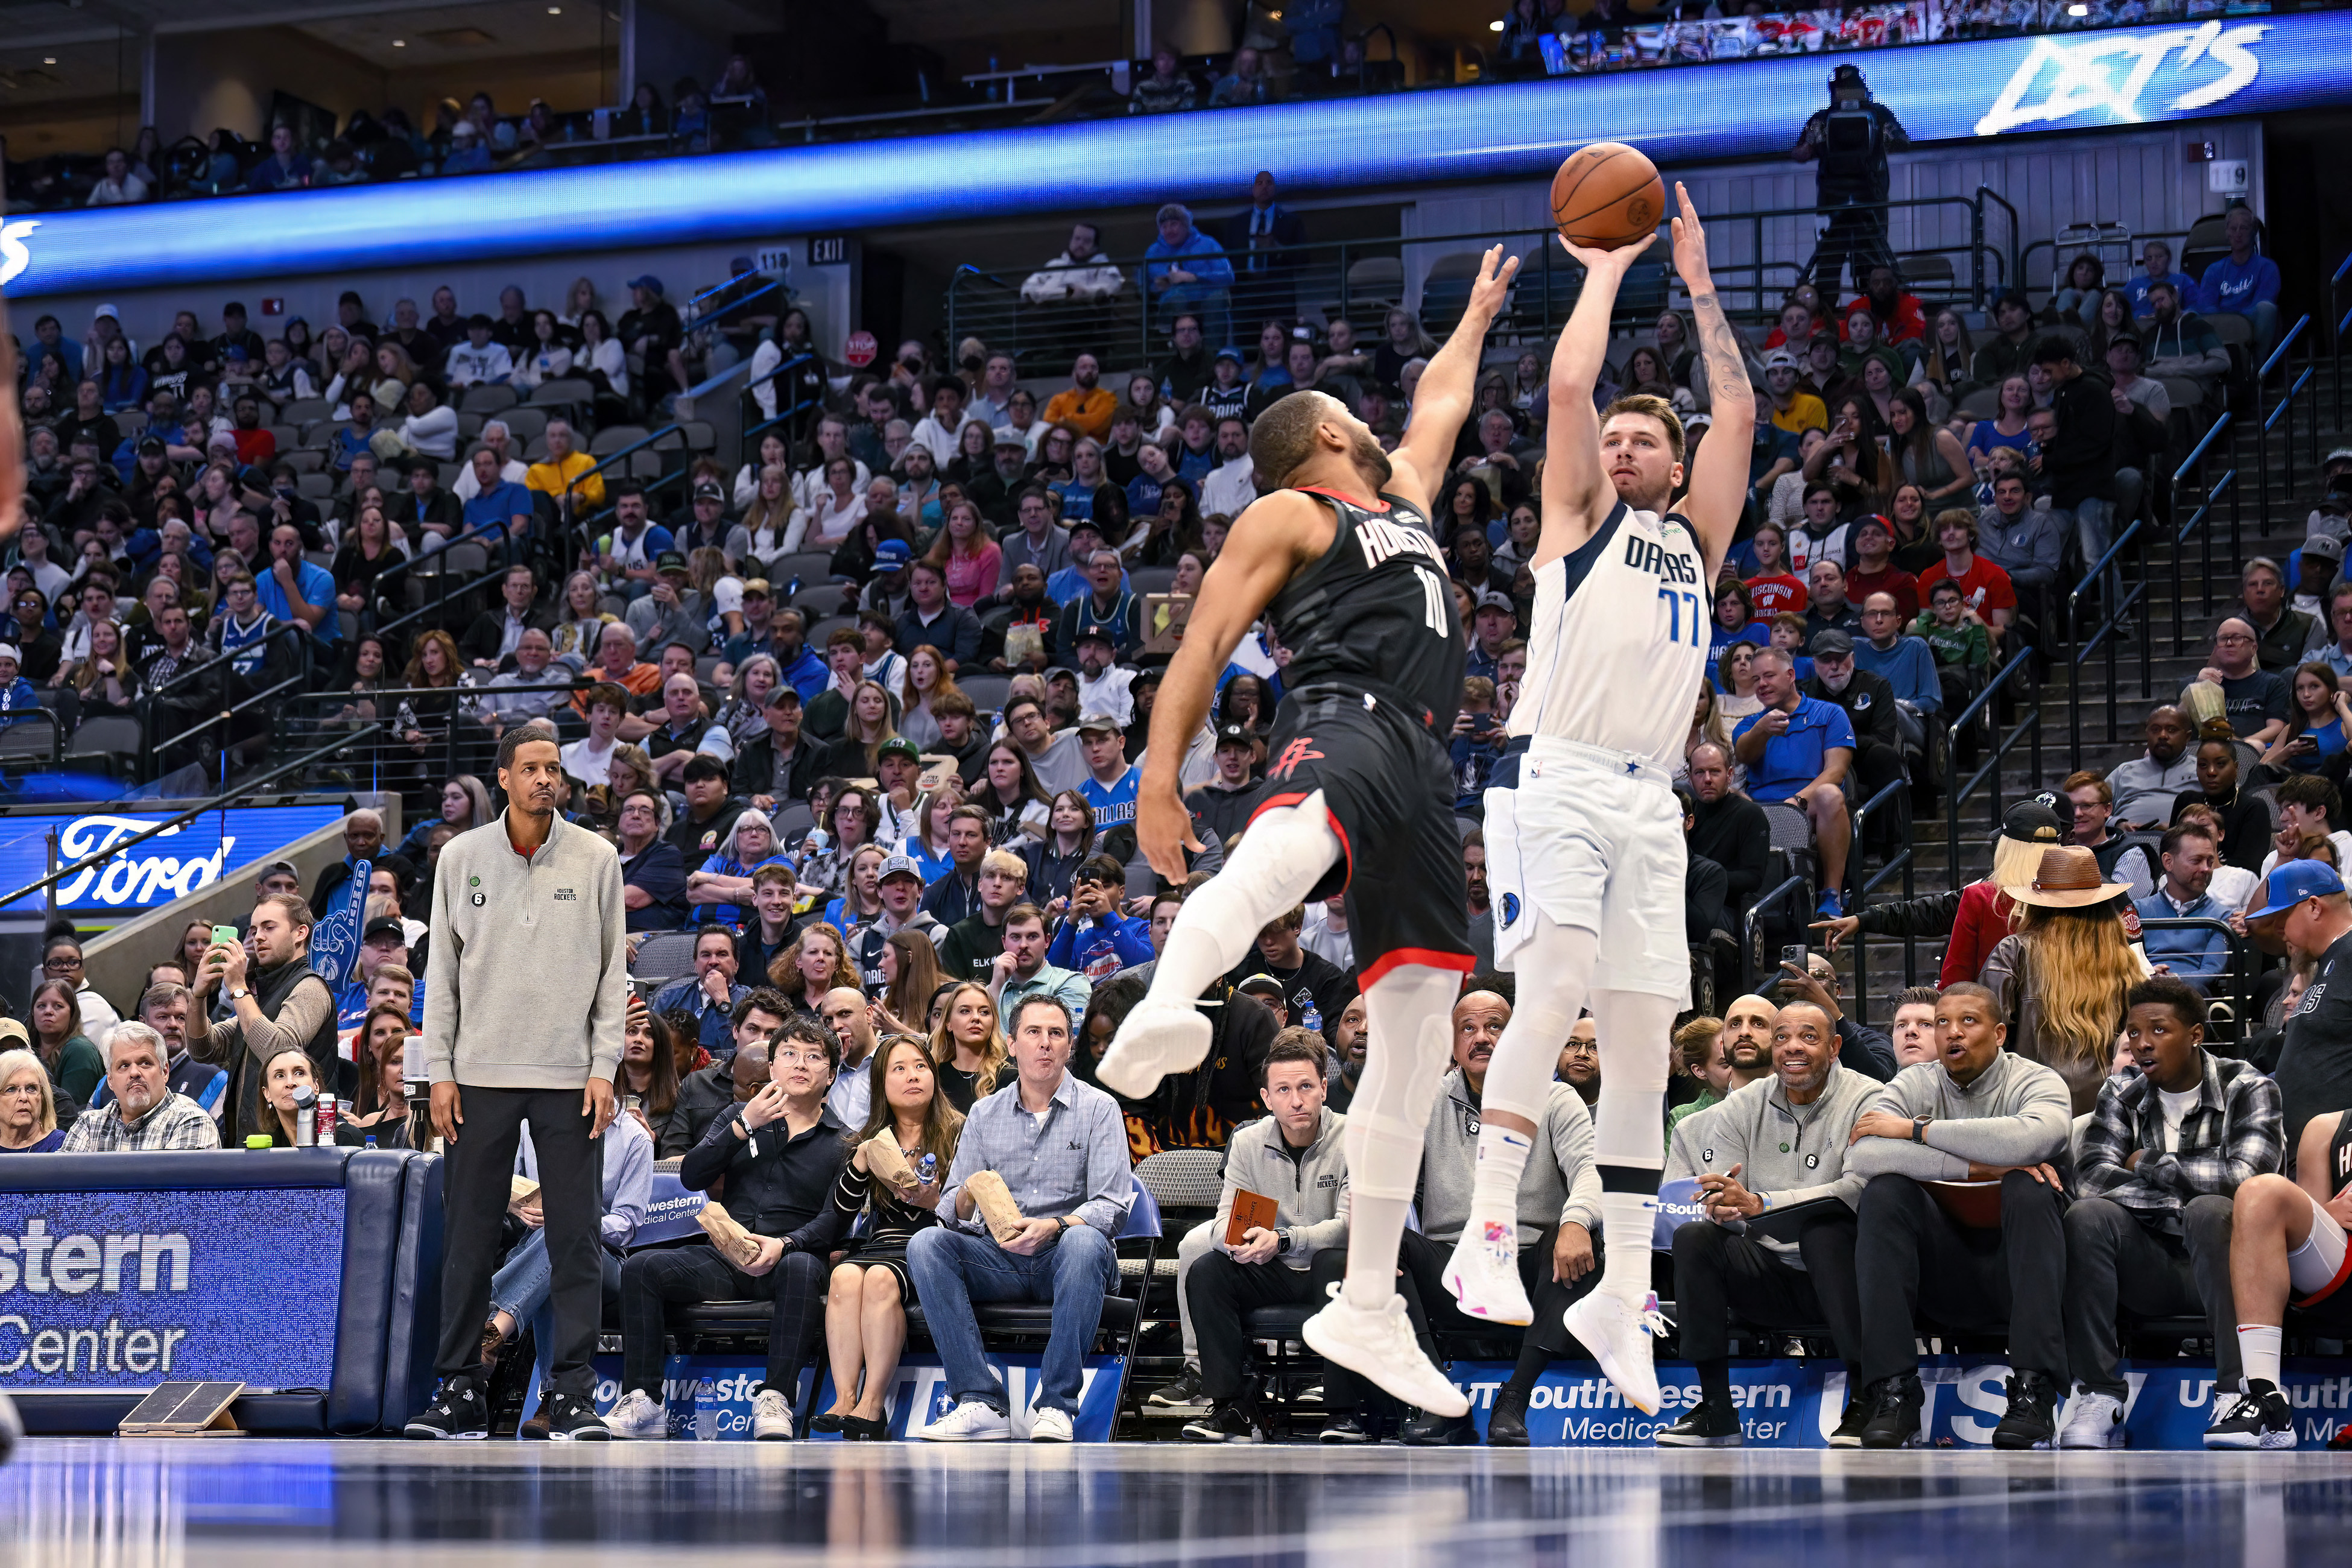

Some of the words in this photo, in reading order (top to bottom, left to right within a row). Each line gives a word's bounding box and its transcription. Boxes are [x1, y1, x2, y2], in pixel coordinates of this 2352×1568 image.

[1974, 20, 2275, 136] LET'S
[2214, 167, 2246, 185] 119
[814, 238, 844, 262] EXIT
[1414, 564, 1448, 638] 10
[1658, 588, 1698, 648] 77
[1092, 801, 1136, 825] ALLAS
[41, 815, 236, 906] Ford
[475, 893, 482, 905] 6
[973, 958, 990, 967] ELK
[1469, 1121, 1480, 1133] 6
[1704, 1149, 1713, 1160] 6
[1807, 1155, 1816, 1168] 6
[1317, 1180, 1338, 1189] ROCKETS
[668, 1207, 701, 1221] Center
[0, 1219, 191, 1295] stern
[0, 1315, 186, 1374] Center
